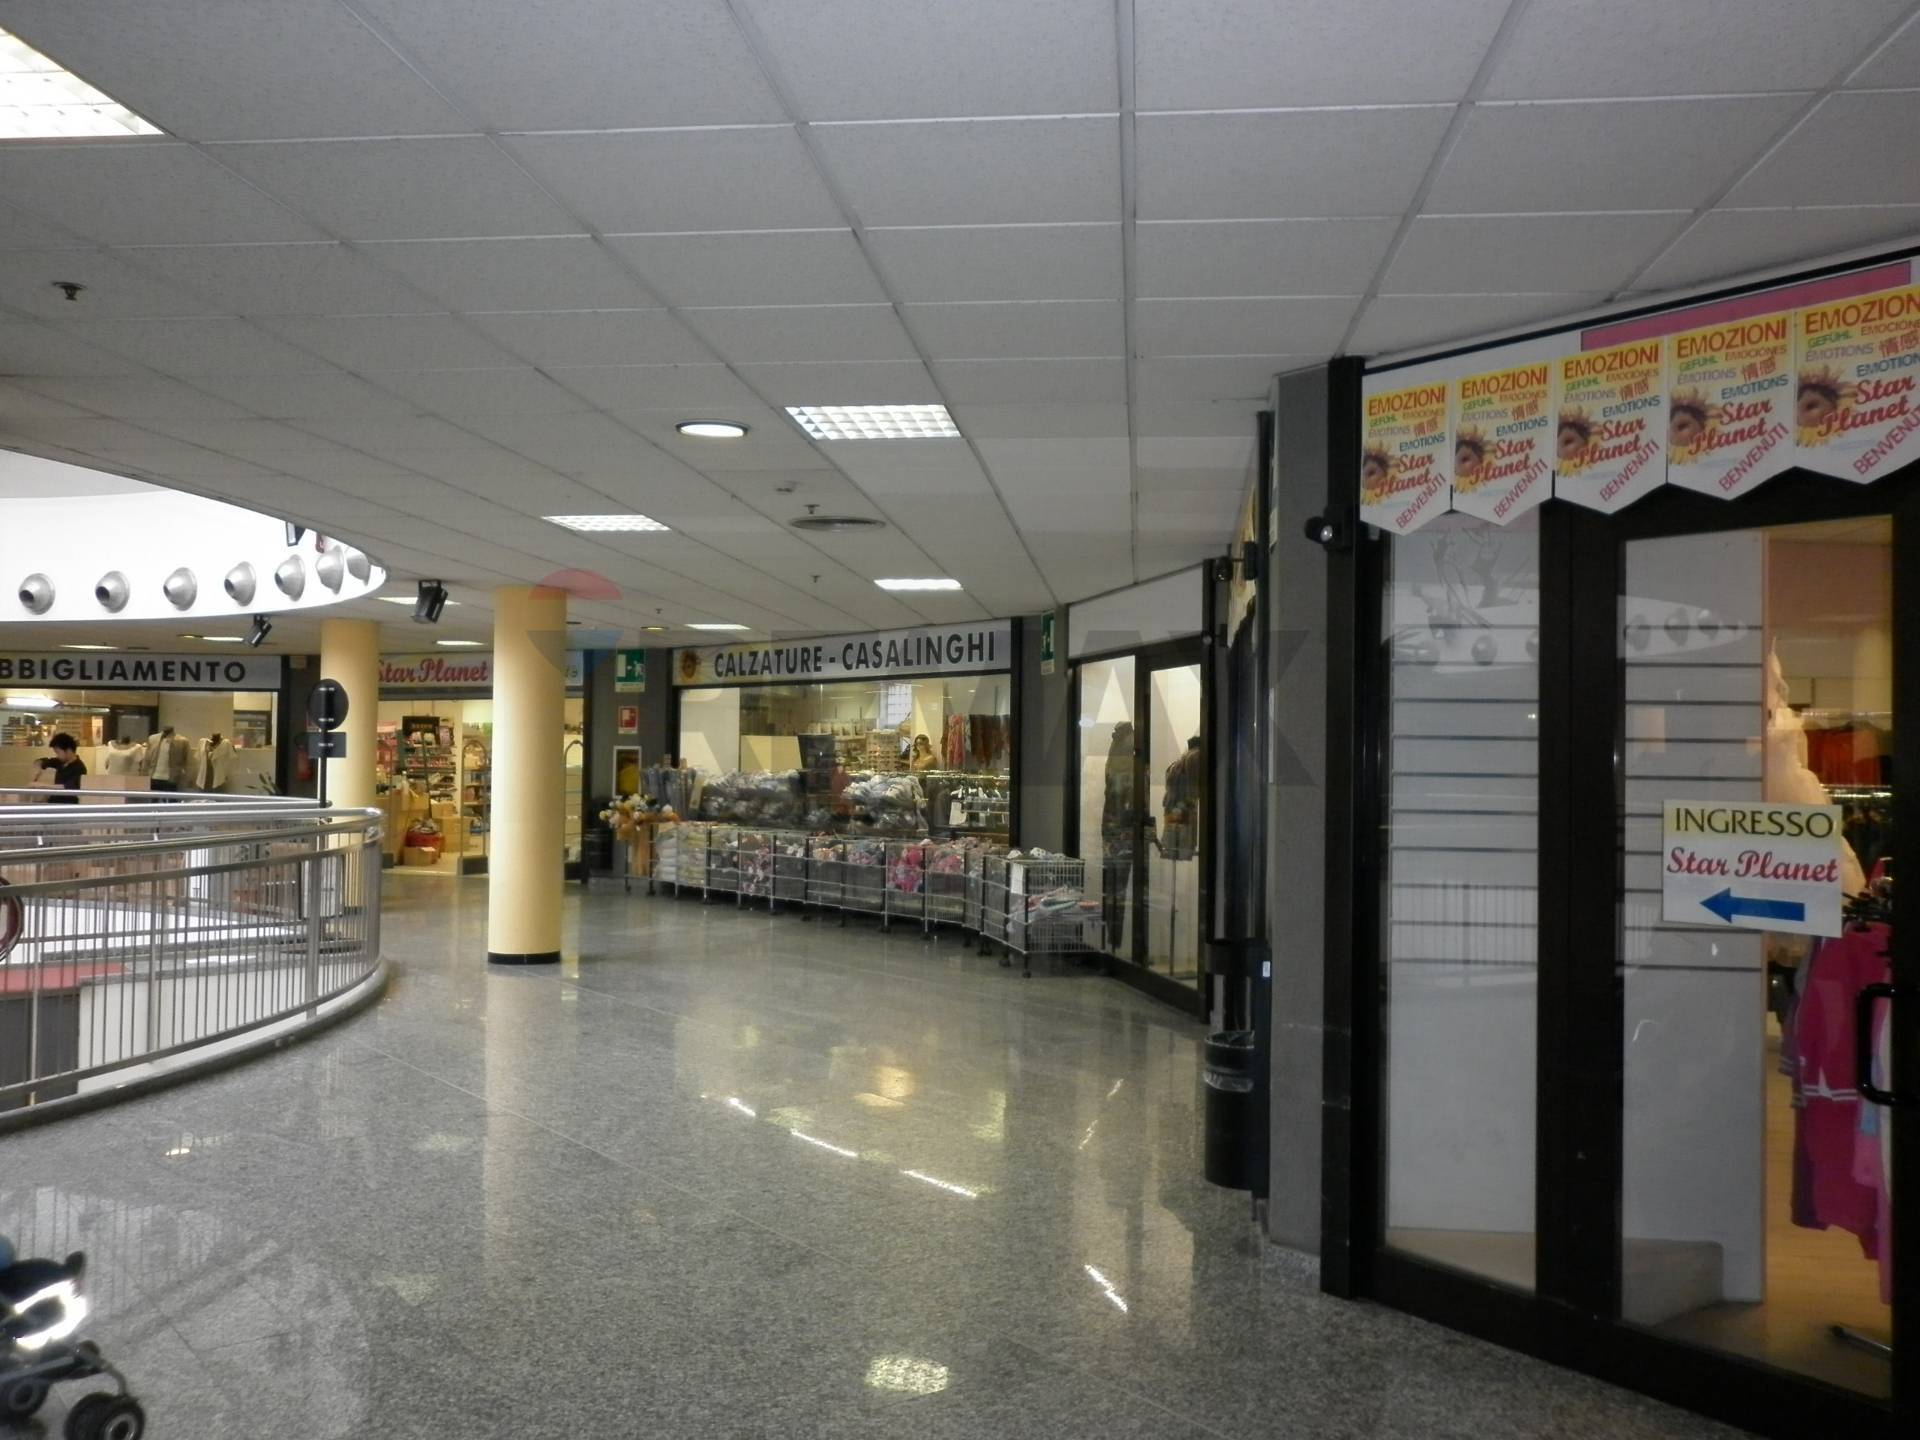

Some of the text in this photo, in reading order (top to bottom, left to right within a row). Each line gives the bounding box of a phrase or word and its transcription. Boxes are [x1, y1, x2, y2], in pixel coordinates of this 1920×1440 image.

[1677, 318, 1787, 359] EMOZIONI
[1805, 342, 1873, 362] EMOTIONS
[1564, 343, 1658, 379] EMOZIONI
[1462, 366, 1547, 399] EMOZIONI
[1721, 375, 1788, 400] EMOTIONS
[1855, 375, 1916, 404] Star
[1369, 386, 1444, 416] EMOZIONI
[1603, 396, 1660, 418] EMOTIONS
[1720, 398, 1772, 426] Star
[1818, 395, 1909, 437] Planet
[1496, 416, 1548, 436] EMOTIONS
[1601, 416, 1646, 442] Star
[1688, 417, 1768, 455] Planet
[1400, 432, 1445, 452] EMOTIONS
[1495, 436, 1535, 459] Star
[1573, 435, 1642, 468] Planet
[1719, 422, 1789, 491] BENVENUTI
[1398, 452, 1435, 473] Star
[1470, 452, 1530, 485] Planet
[1600, 438, 1660, 502] BENVENUTI
[1375, 468, 1431, 498] Planet
[1494, 459, 1547, 518] BENVENUTI
[1396, 473, 1446, 528] BENVENUTI
[714, 646, 822, 677] CALZATURE
[842, 631, 995, 670] CASALINGHI
[0, 658, 246, 682] BBIGLIAMENTO
[418, 658, 489, 683] Planet
[1676, 808, 1833, 838] INGRESSO
[1667, 846, 1839, 883] Star Planet
